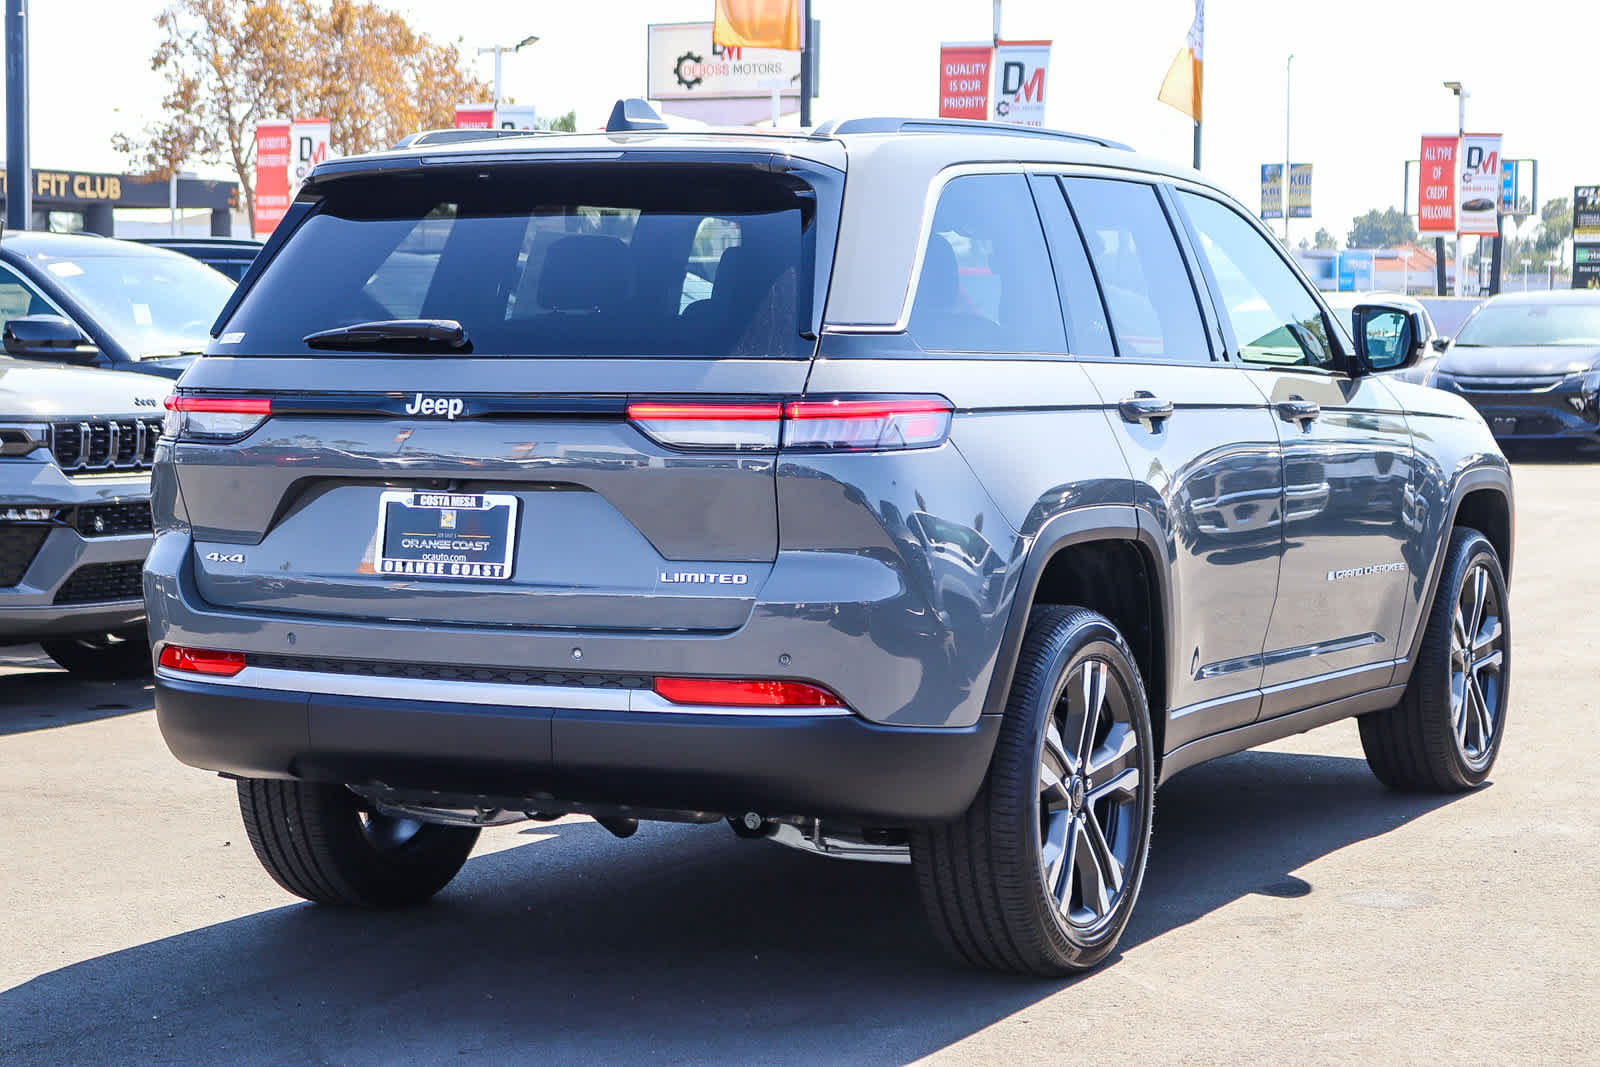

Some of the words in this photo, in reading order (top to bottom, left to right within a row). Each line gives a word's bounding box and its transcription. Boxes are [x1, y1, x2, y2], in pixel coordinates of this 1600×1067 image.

[733, 62, 783, 74] MOTORS
[945, 63, 987, 76] QUALITY
[950, 80, 959, 92] IS
[960, 79, 981, 92] OUR
[1003, 61, 1045, 103] DM
[943, 96, 986, 109] PRIORITY
[1425, 147, 1437, 160] ALL
[1438, 147, 1453, 161] TYPE
[1467, 146, 1498, 175] DM
[1432, 166, 1443, 180] OF
[38, 172, 70, 197] FIT
[73, 174, 122, 199] CLUB
[1426, 186, 1449, 200] CREDIT
[1421, 205, 1453, 219] WELCOME
[405, 392, 464, 420] Jeep
[420, 495, 450, 507] COSTA
[451, 496, 477, 508] MESA
[401, 538, 451, 550] ORANGE
[452, 540, 490, 551] COAST
[206, 552, 246, 563] 4x4
[422, 552, 467, 563] ocauto.com
[384, 560, 445, 575] ORANGE
[451, 563, 502, 577] COAST
[1336, 567, 1364, 580] GRAND
[1365, 562, 1406, 575] CHEROKEE
[661, 572, 748, 584] LIMITED
